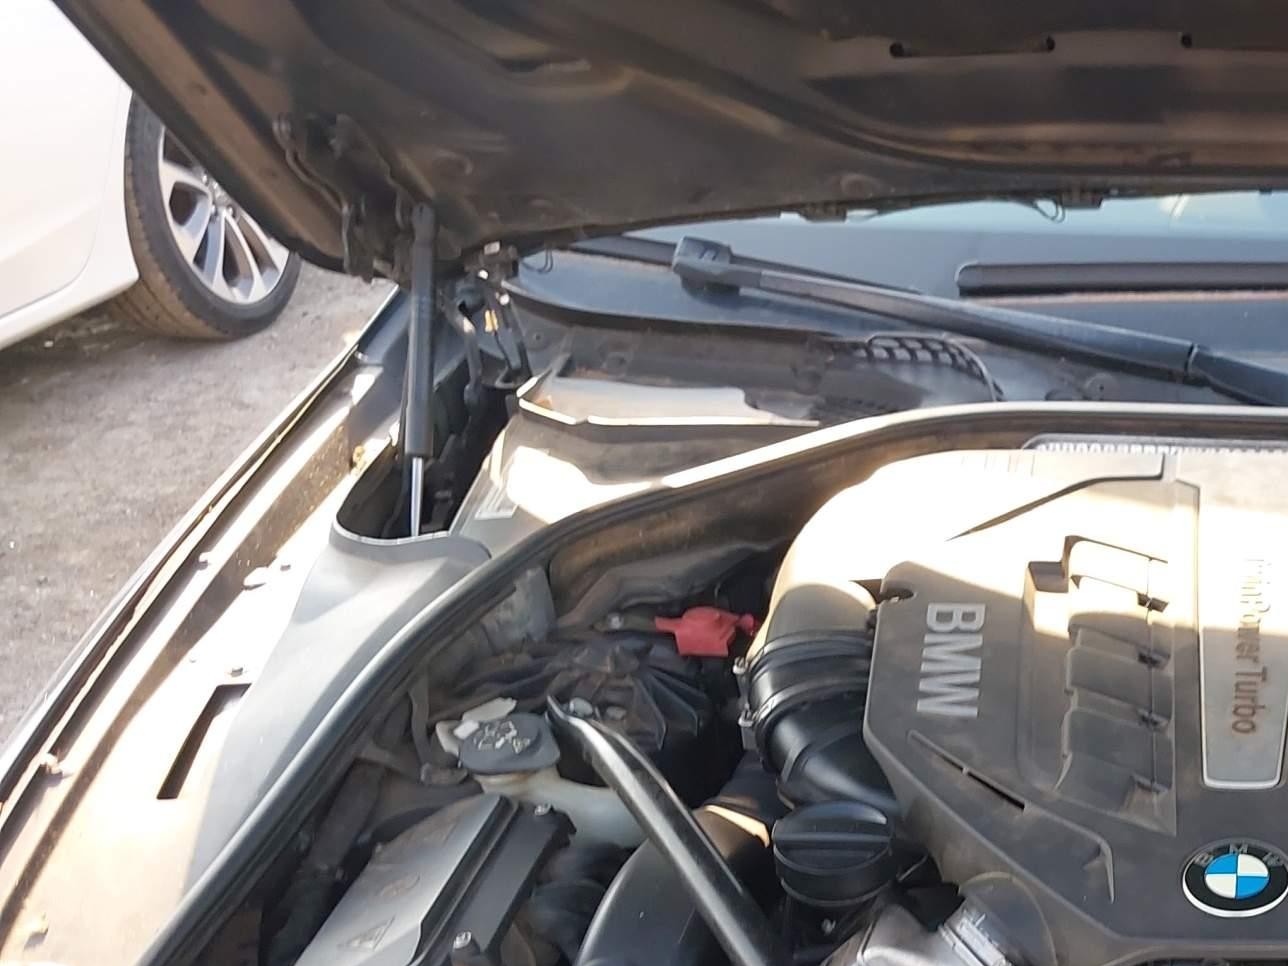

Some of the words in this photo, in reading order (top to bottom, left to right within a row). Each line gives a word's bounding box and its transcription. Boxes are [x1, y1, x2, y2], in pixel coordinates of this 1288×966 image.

[1236, 553, 1272, 664] inPower
[917, 602, 986, 718] BMW
[1232, 665, 1268, 735] Turbo
[1193, 843, 1285, 868] BMW
